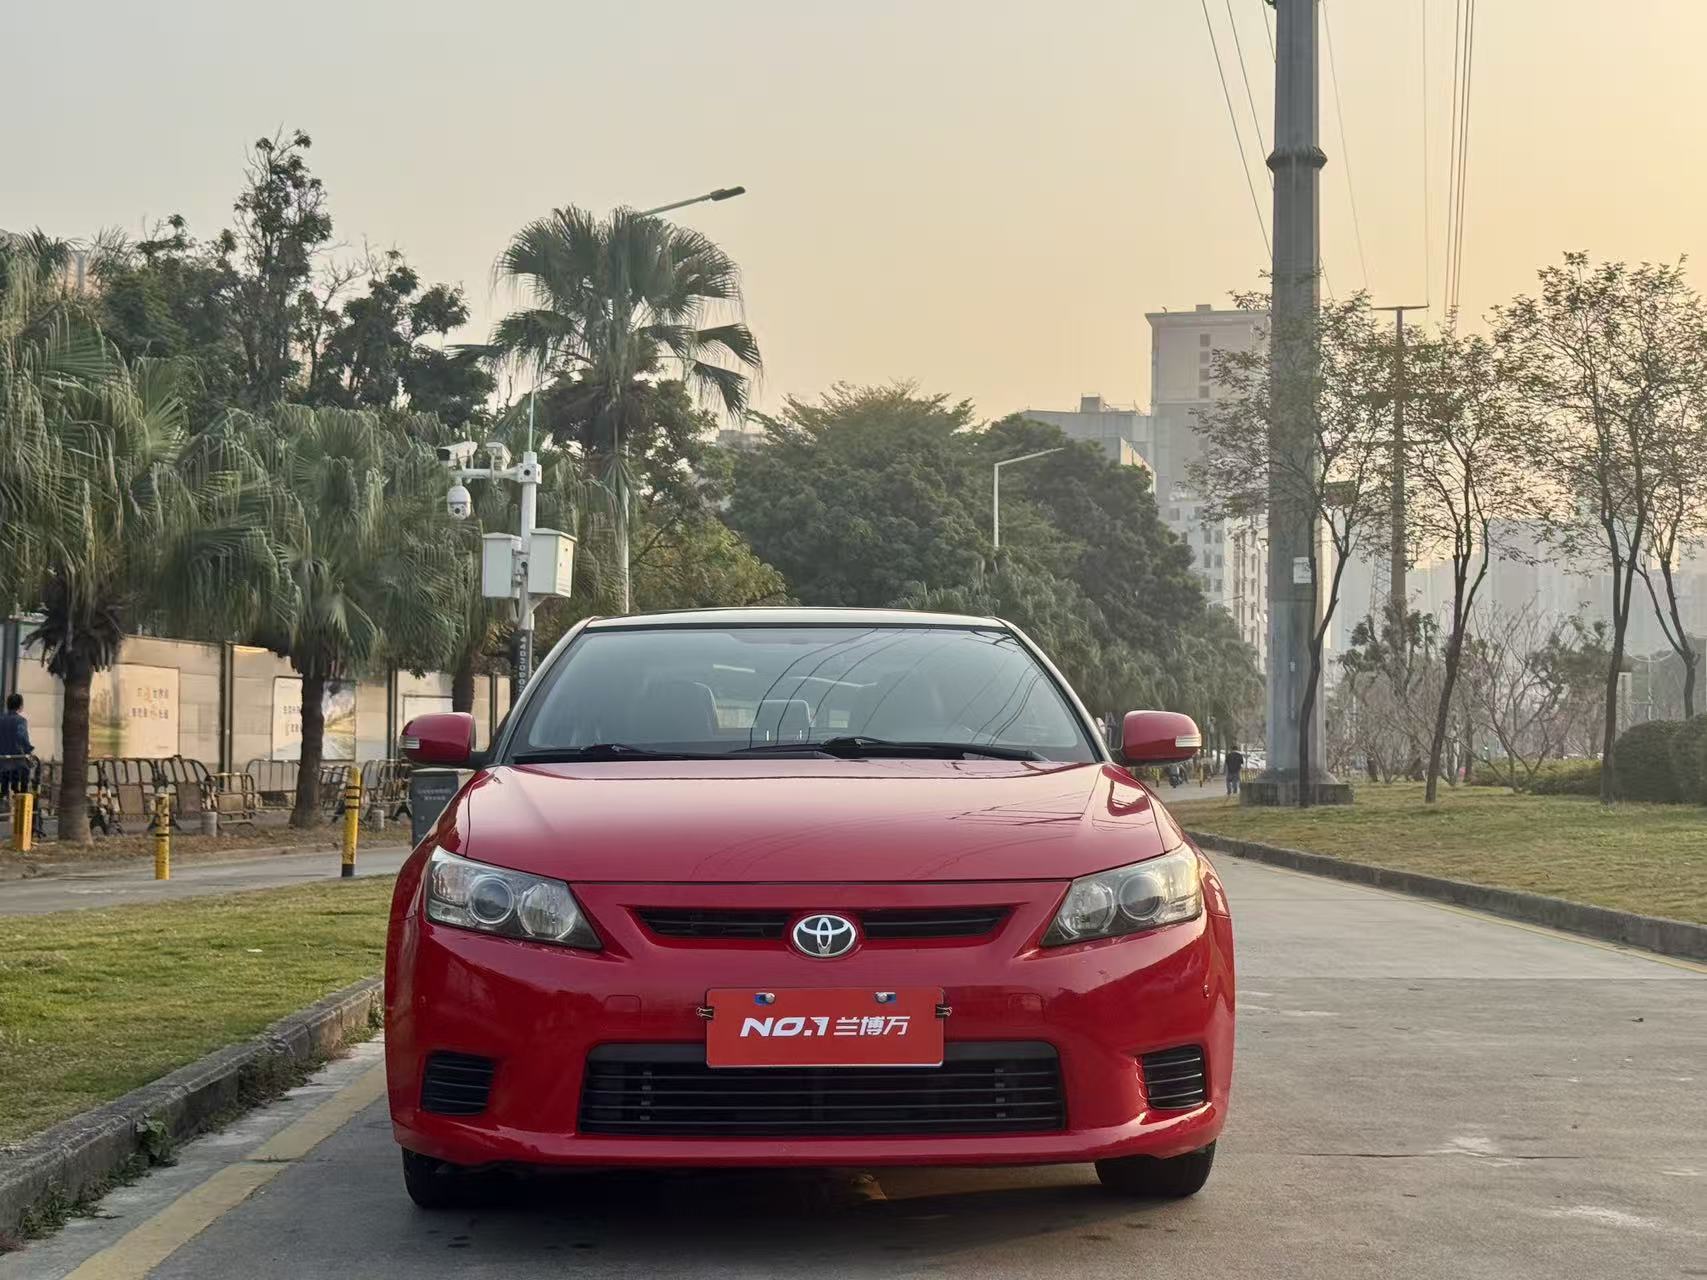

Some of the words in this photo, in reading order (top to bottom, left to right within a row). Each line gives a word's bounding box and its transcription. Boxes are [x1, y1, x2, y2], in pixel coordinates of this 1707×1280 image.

[740, 1016, 829, 1037] NO.1
[833, 1015, 911, 1036] 兰博万
